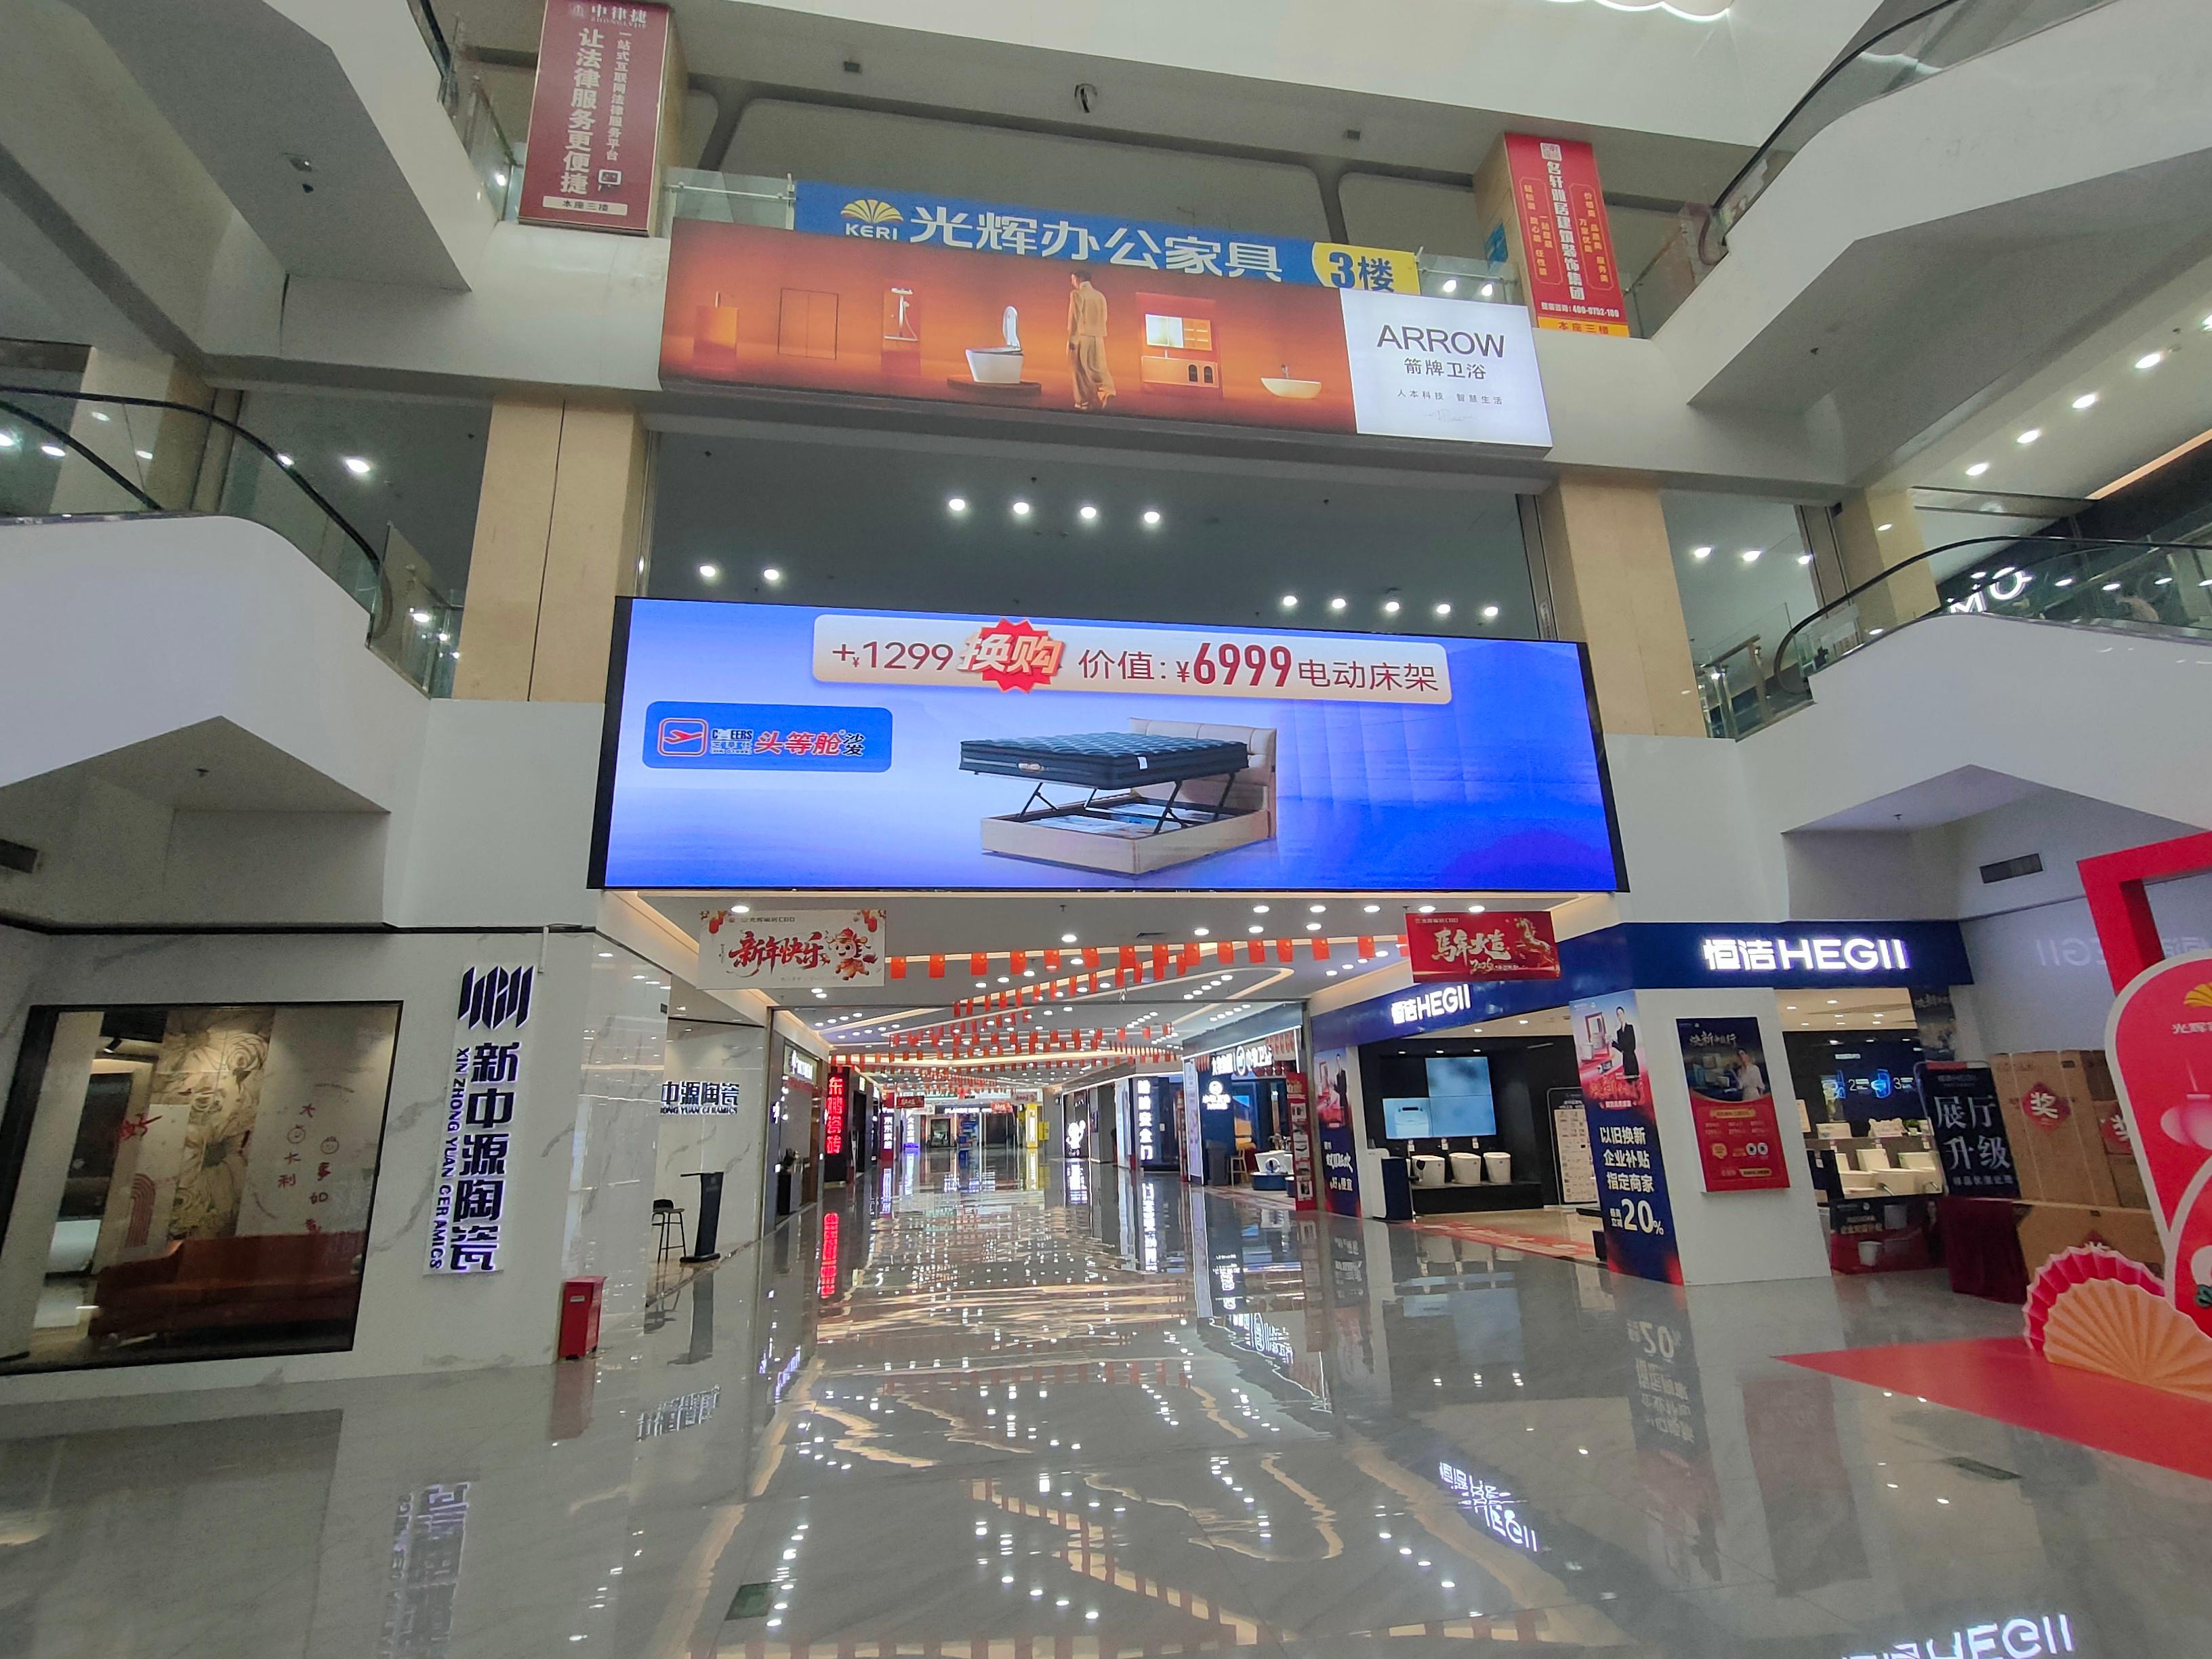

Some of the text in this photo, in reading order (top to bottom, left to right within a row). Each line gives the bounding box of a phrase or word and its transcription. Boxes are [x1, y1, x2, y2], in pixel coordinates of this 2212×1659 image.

[560, 28, 605, 195] 让法律服务更便捷
[845, 222, 898, 241] KERI
[910, 205, 1283, 282] 光辉办公家具
[1328, 251, 1395, 292] 3楼
[1376, 324, 1505, 358] ARROW
[1404, 357, 1486, 380] 箭牌卫浴
[1397, 388, 1503, 406] 人本科技 智慧生活
[957, 630, 1065, 676] 换购
[1298, 657, 1439, 692] 电动床架
[754, 731, 840, 756] 头等舱
[728, 930, 825, 975] 新年快乐
[1703, 938, 1909, 970] 恒洁 HEGII
[1416, 984, 1471, 1020] HEGII
[826, 1077, 843, 1154] 东鹏瓷砖
[1933, 1094, 1997, 1130] 展厅
[2030, 1092, 2058, 1120] 奖
[1599, 1126, 1646, 1145] 以旧换新
[429, 1047, 470, 1270] XIN ZHONG YUAN CERAMICS
[450, 1042, 520, 1271] 新中源陶瓷
[1603, 1149, 1651, 1170] 企业补贴
[1943, 1136, 2011, 1172] 升级
[1607, 1172, 1654, 1193] 指定商家
[1621, 1198, 1664, 1235] 20%
